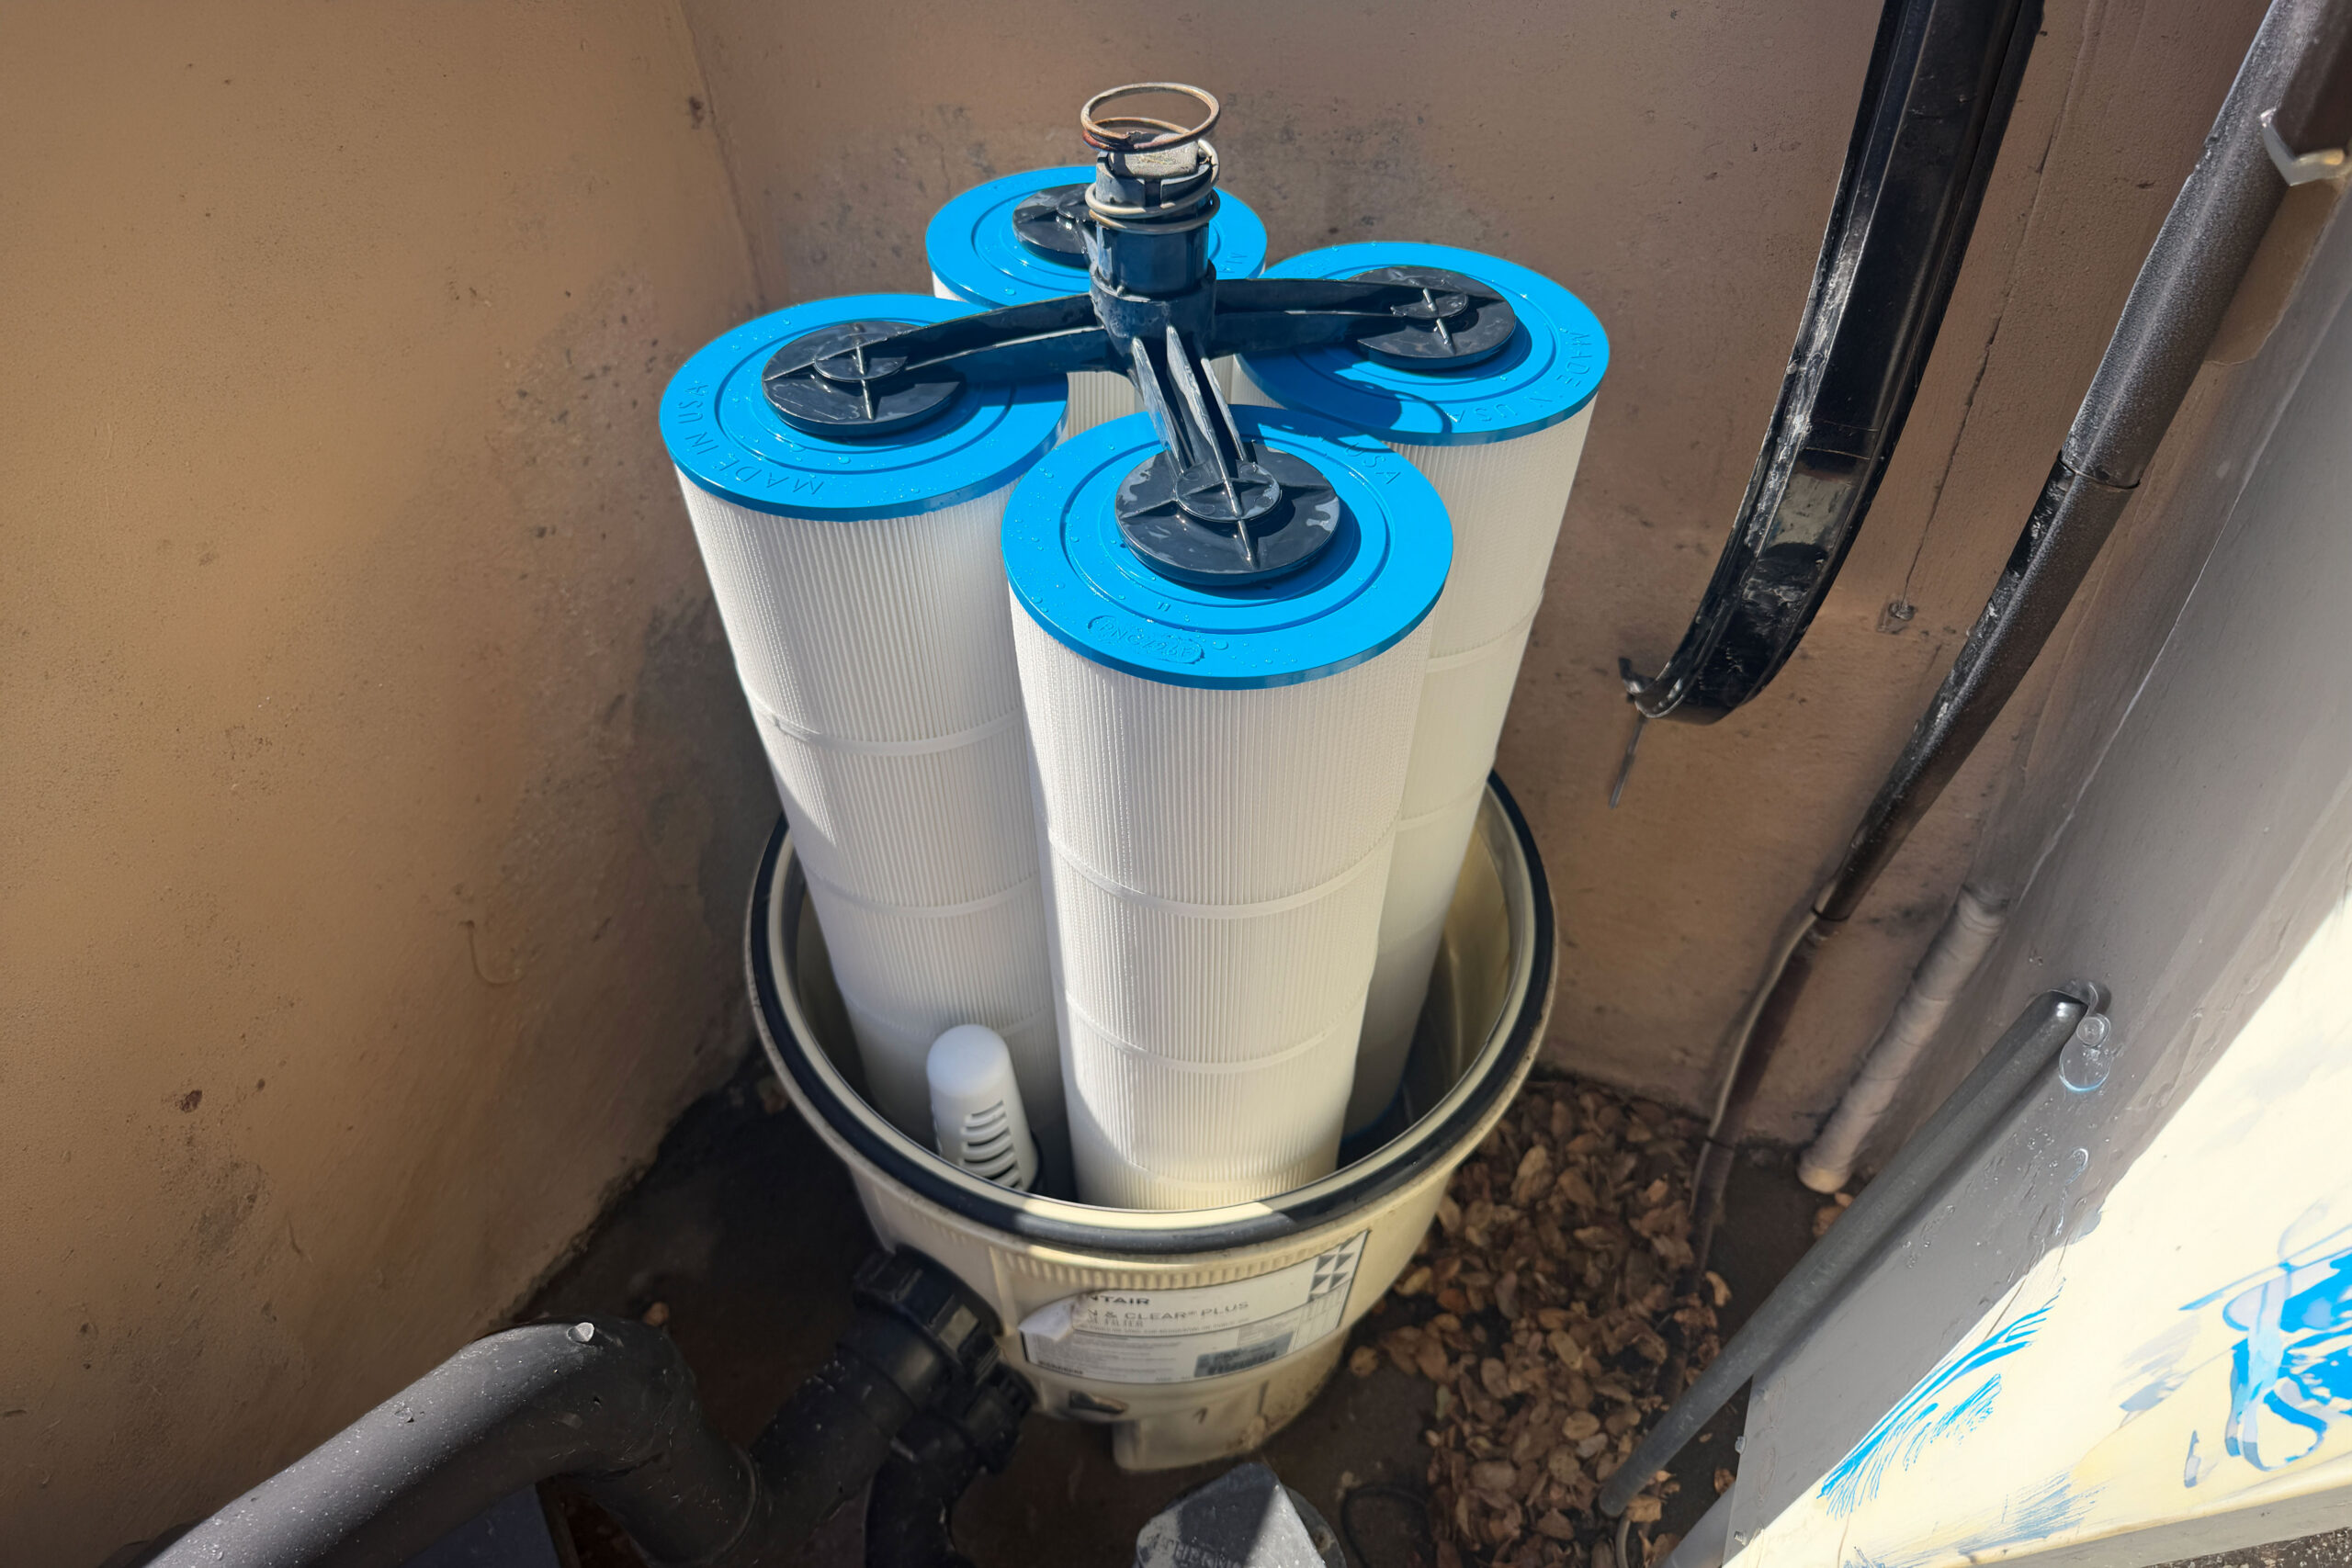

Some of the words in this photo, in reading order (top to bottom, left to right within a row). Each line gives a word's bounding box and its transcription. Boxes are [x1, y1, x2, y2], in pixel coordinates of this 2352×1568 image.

[675, 384, 709, 424] USA
[1447, 403, 1519, 423] USA
[684, 432, 719, 456] IN
[715, 454, 824, 495] MADE
[1345, 442, 1402, 485] USA
[1089, 1294, 1150, 1305] NTAIR
[1201, 1302, 1249, 1316] PLUS
